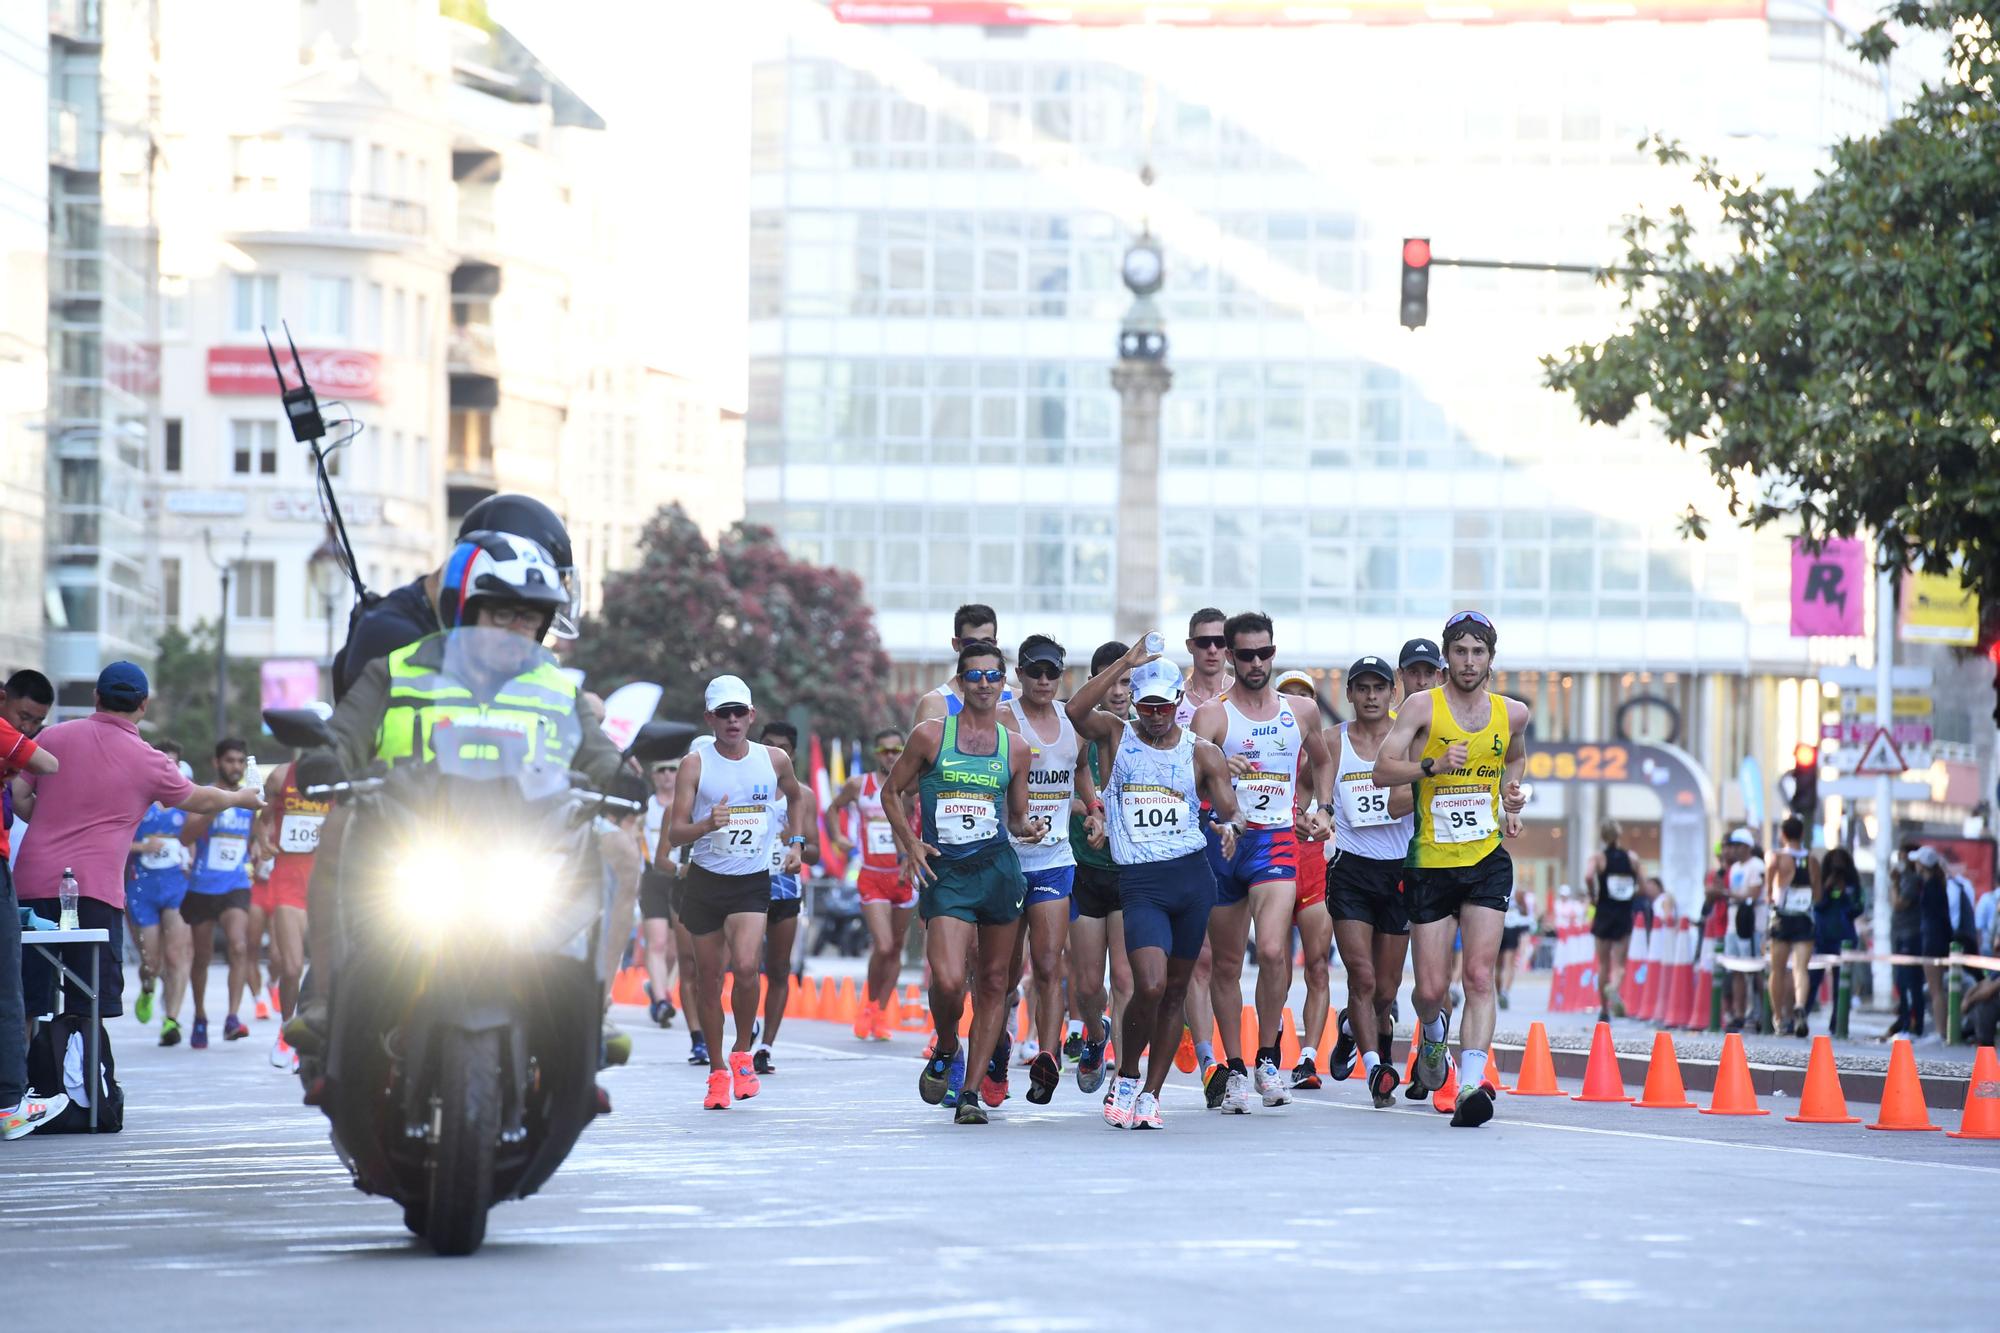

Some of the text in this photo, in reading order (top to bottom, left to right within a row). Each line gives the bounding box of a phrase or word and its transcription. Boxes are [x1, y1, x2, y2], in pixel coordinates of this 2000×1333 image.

[1251, 725, 1278, 737] aula
[1527, 745, 1629, 780] es22
[942, 770, 1000, 789] BRASIL
[1027, 769, 1070, 785] CUADOR
[752, 793, 768, 801] GUA
[1246, 784, 1286, 797] MARTÍN
[1437, 784, 1490, 796] antones22
[1029, 804, 1059, 812] URTADO
[1124, 798, 1133, 806] C.
[1254, 794, 1270, 811] 2
[1357, 794, 1386, 813] 35
[944, 804, 987, 816] BONFIM
[1133, 807, 1179, 828] 104
[728, 817, 760, 826] RRONDO
[962, 814, 976, 831] 5
[1450, 811, 1478, 829] 95
[288, 828, 320, 842] 109
[728, 829, 753, 846] 72
